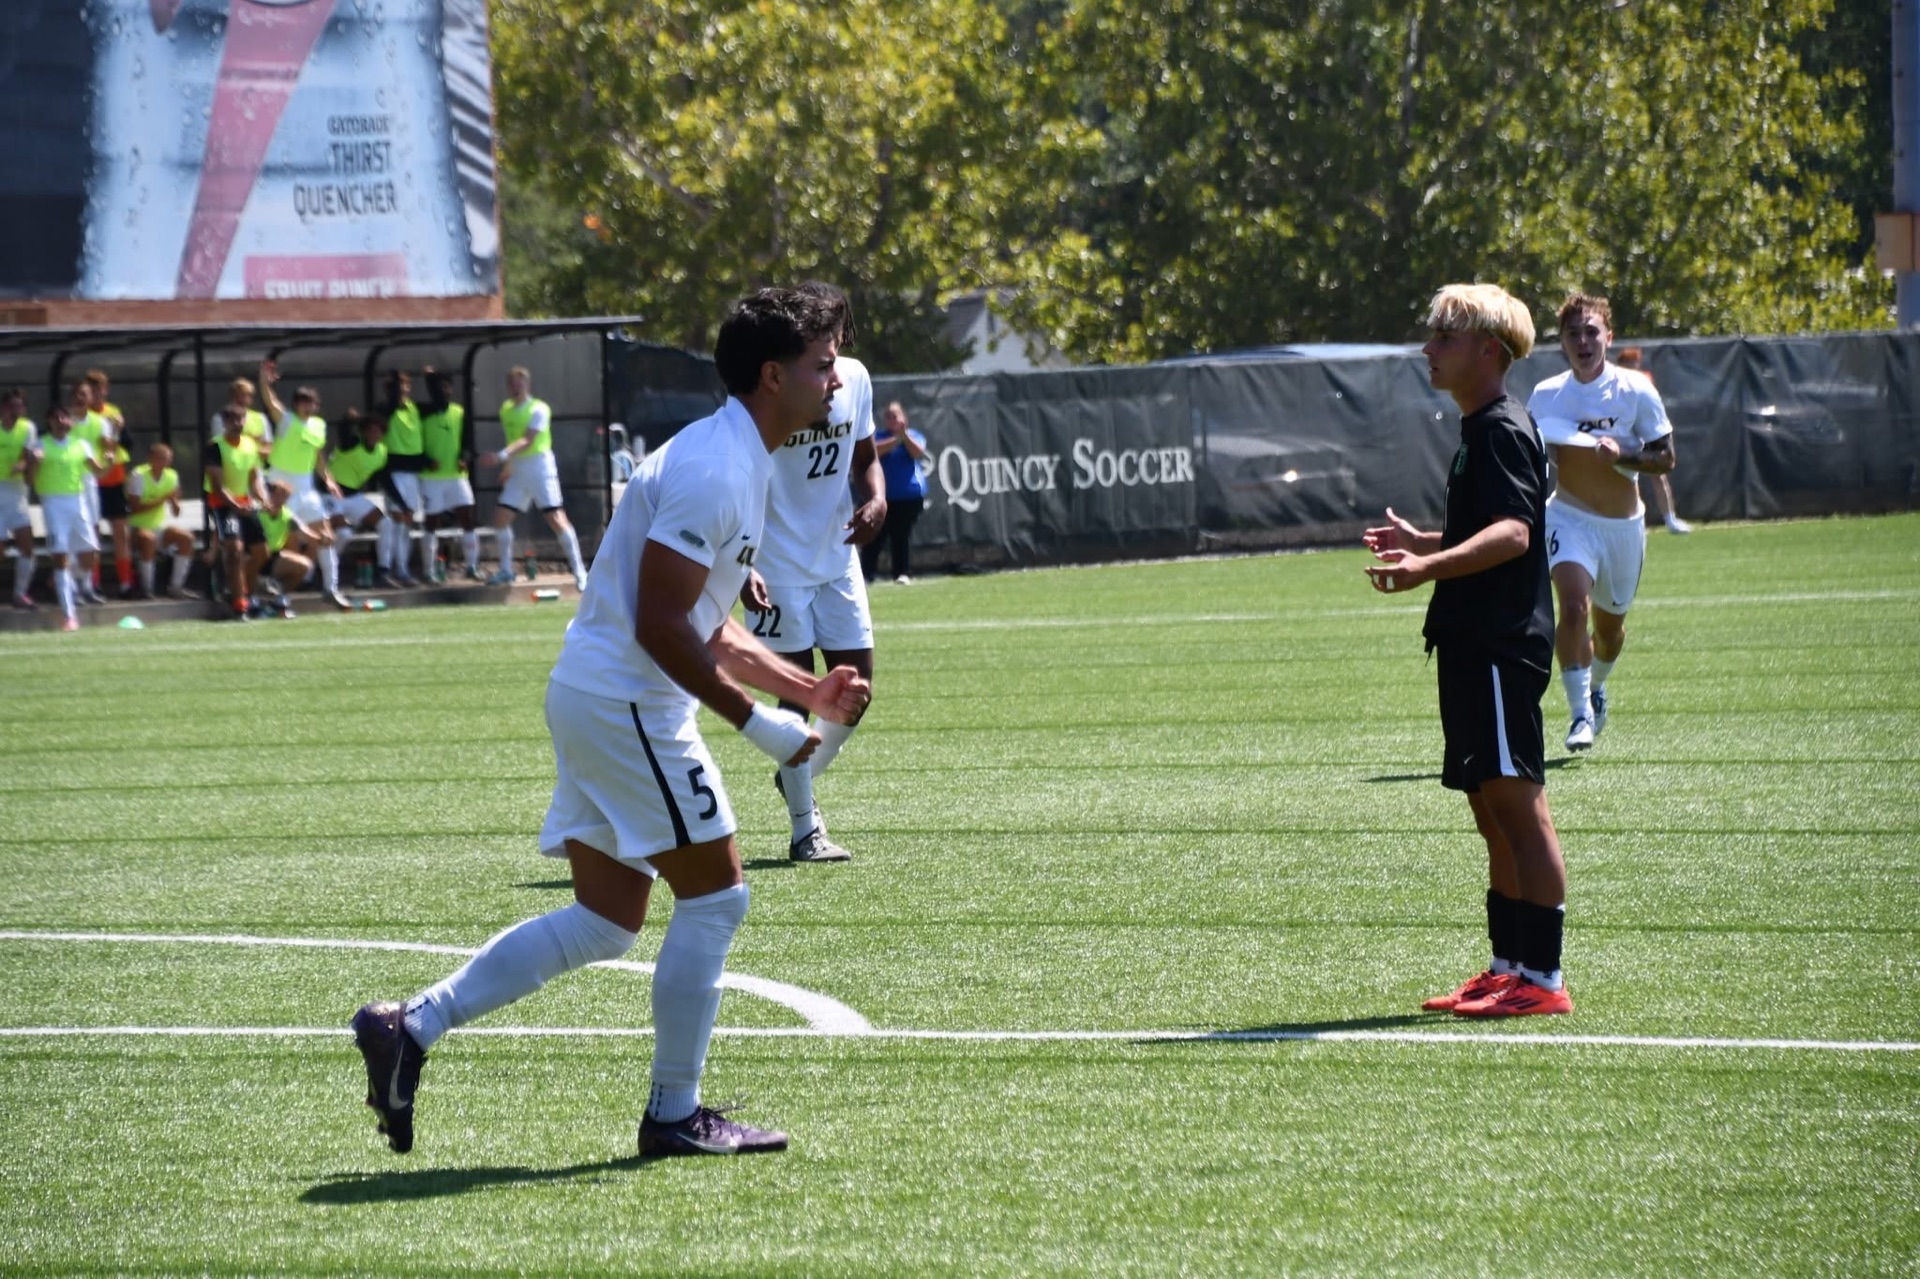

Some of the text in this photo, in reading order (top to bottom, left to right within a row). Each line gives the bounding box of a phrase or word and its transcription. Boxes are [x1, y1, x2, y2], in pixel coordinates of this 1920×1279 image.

[327, 115, 390, 135] GATORADE
[330, 141, 391, 175] THIRST
[293, 181, 398, 224] QUENCHER
[807, 442, 839, 479] 22
[938, 438, 1194, 513] QUINCY SOCCER
[752, 605, 781, 638] 22
[687, 765, 718, 820] 5
